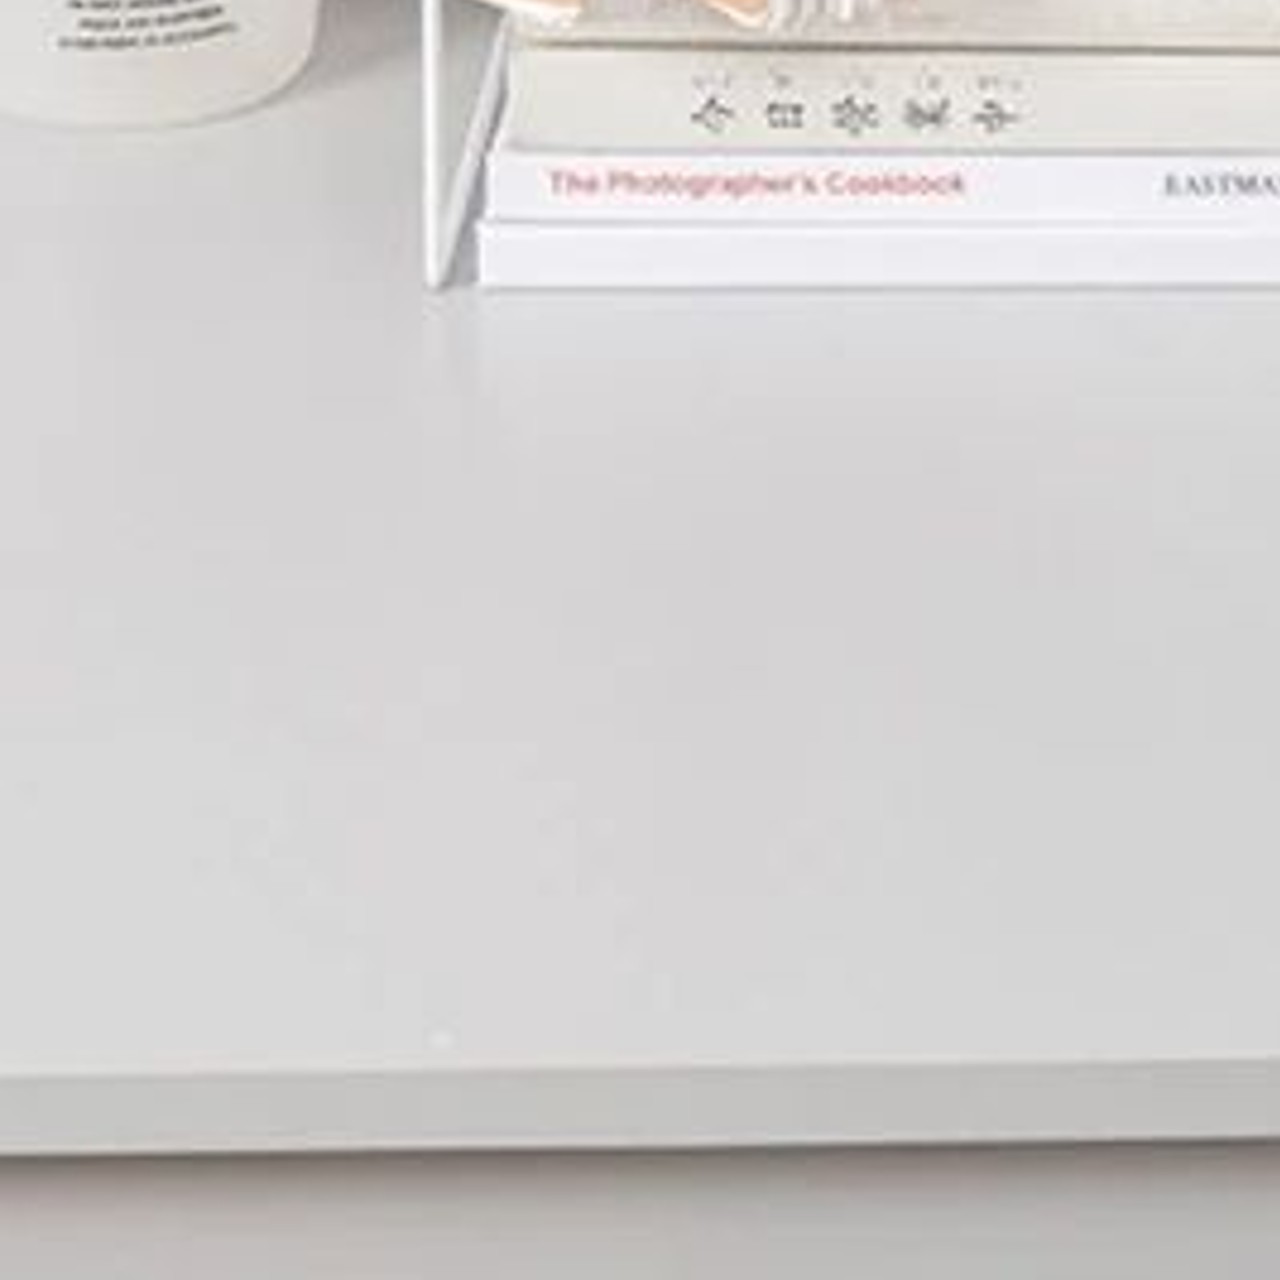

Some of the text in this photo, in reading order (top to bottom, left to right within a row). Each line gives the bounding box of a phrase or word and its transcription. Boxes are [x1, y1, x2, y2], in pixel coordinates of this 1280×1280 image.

[549, 171, 966, 200] The Photographer's Cookbook
